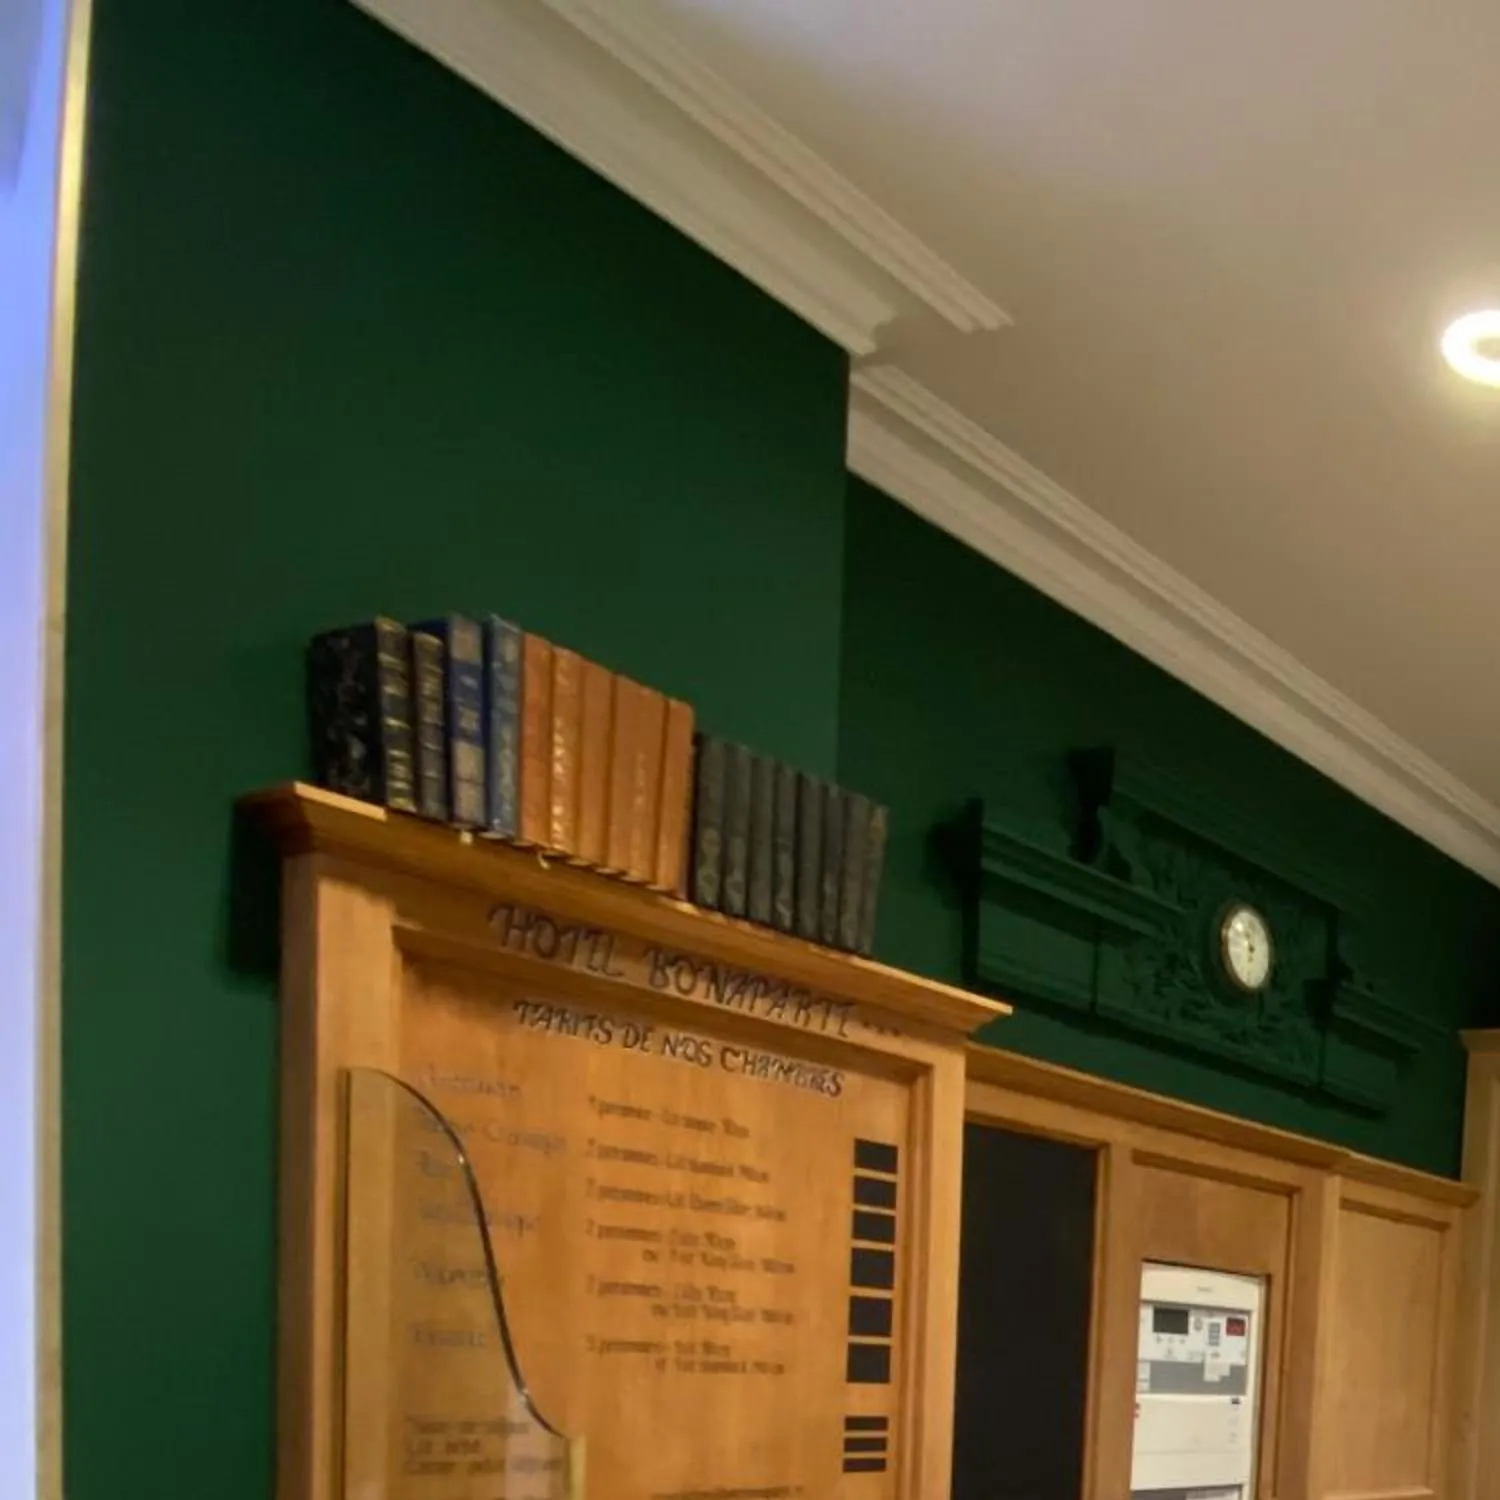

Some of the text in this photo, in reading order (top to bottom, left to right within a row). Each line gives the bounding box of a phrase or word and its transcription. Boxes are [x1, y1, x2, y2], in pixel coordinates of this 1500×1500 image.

[643, 944, 857, 1039] BONAPARTE
[622, 1022, 655, 1053] DE
[662, 1033, 712, 1069] NOS
